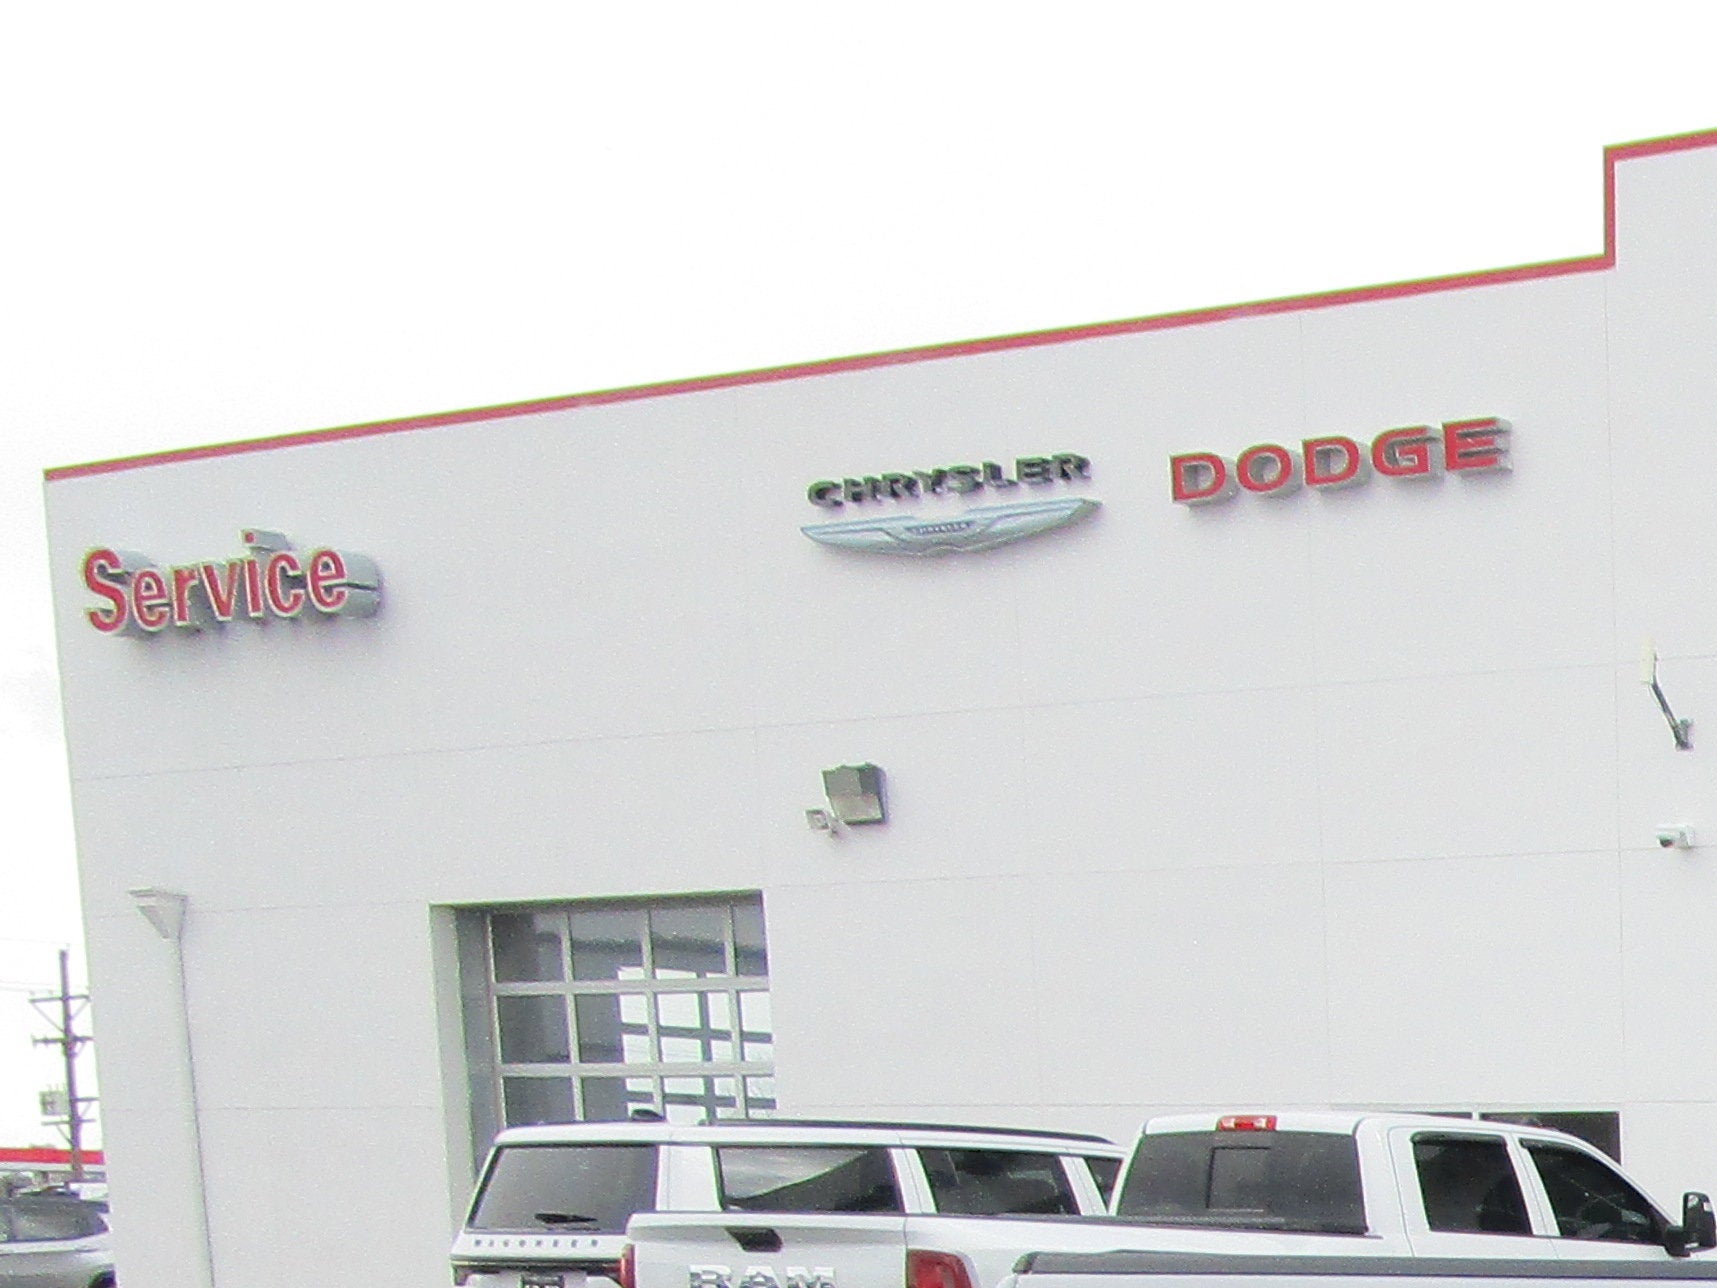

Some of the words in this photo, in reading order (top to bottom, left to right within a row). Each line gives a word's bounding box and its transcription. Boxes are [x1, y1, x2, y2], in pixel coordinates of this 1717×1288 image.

[806, 452, 1093, 508] CHRYSLER
[1168, 415, 1514, 504] DODGE
[82, 527, 352, 634] Service
